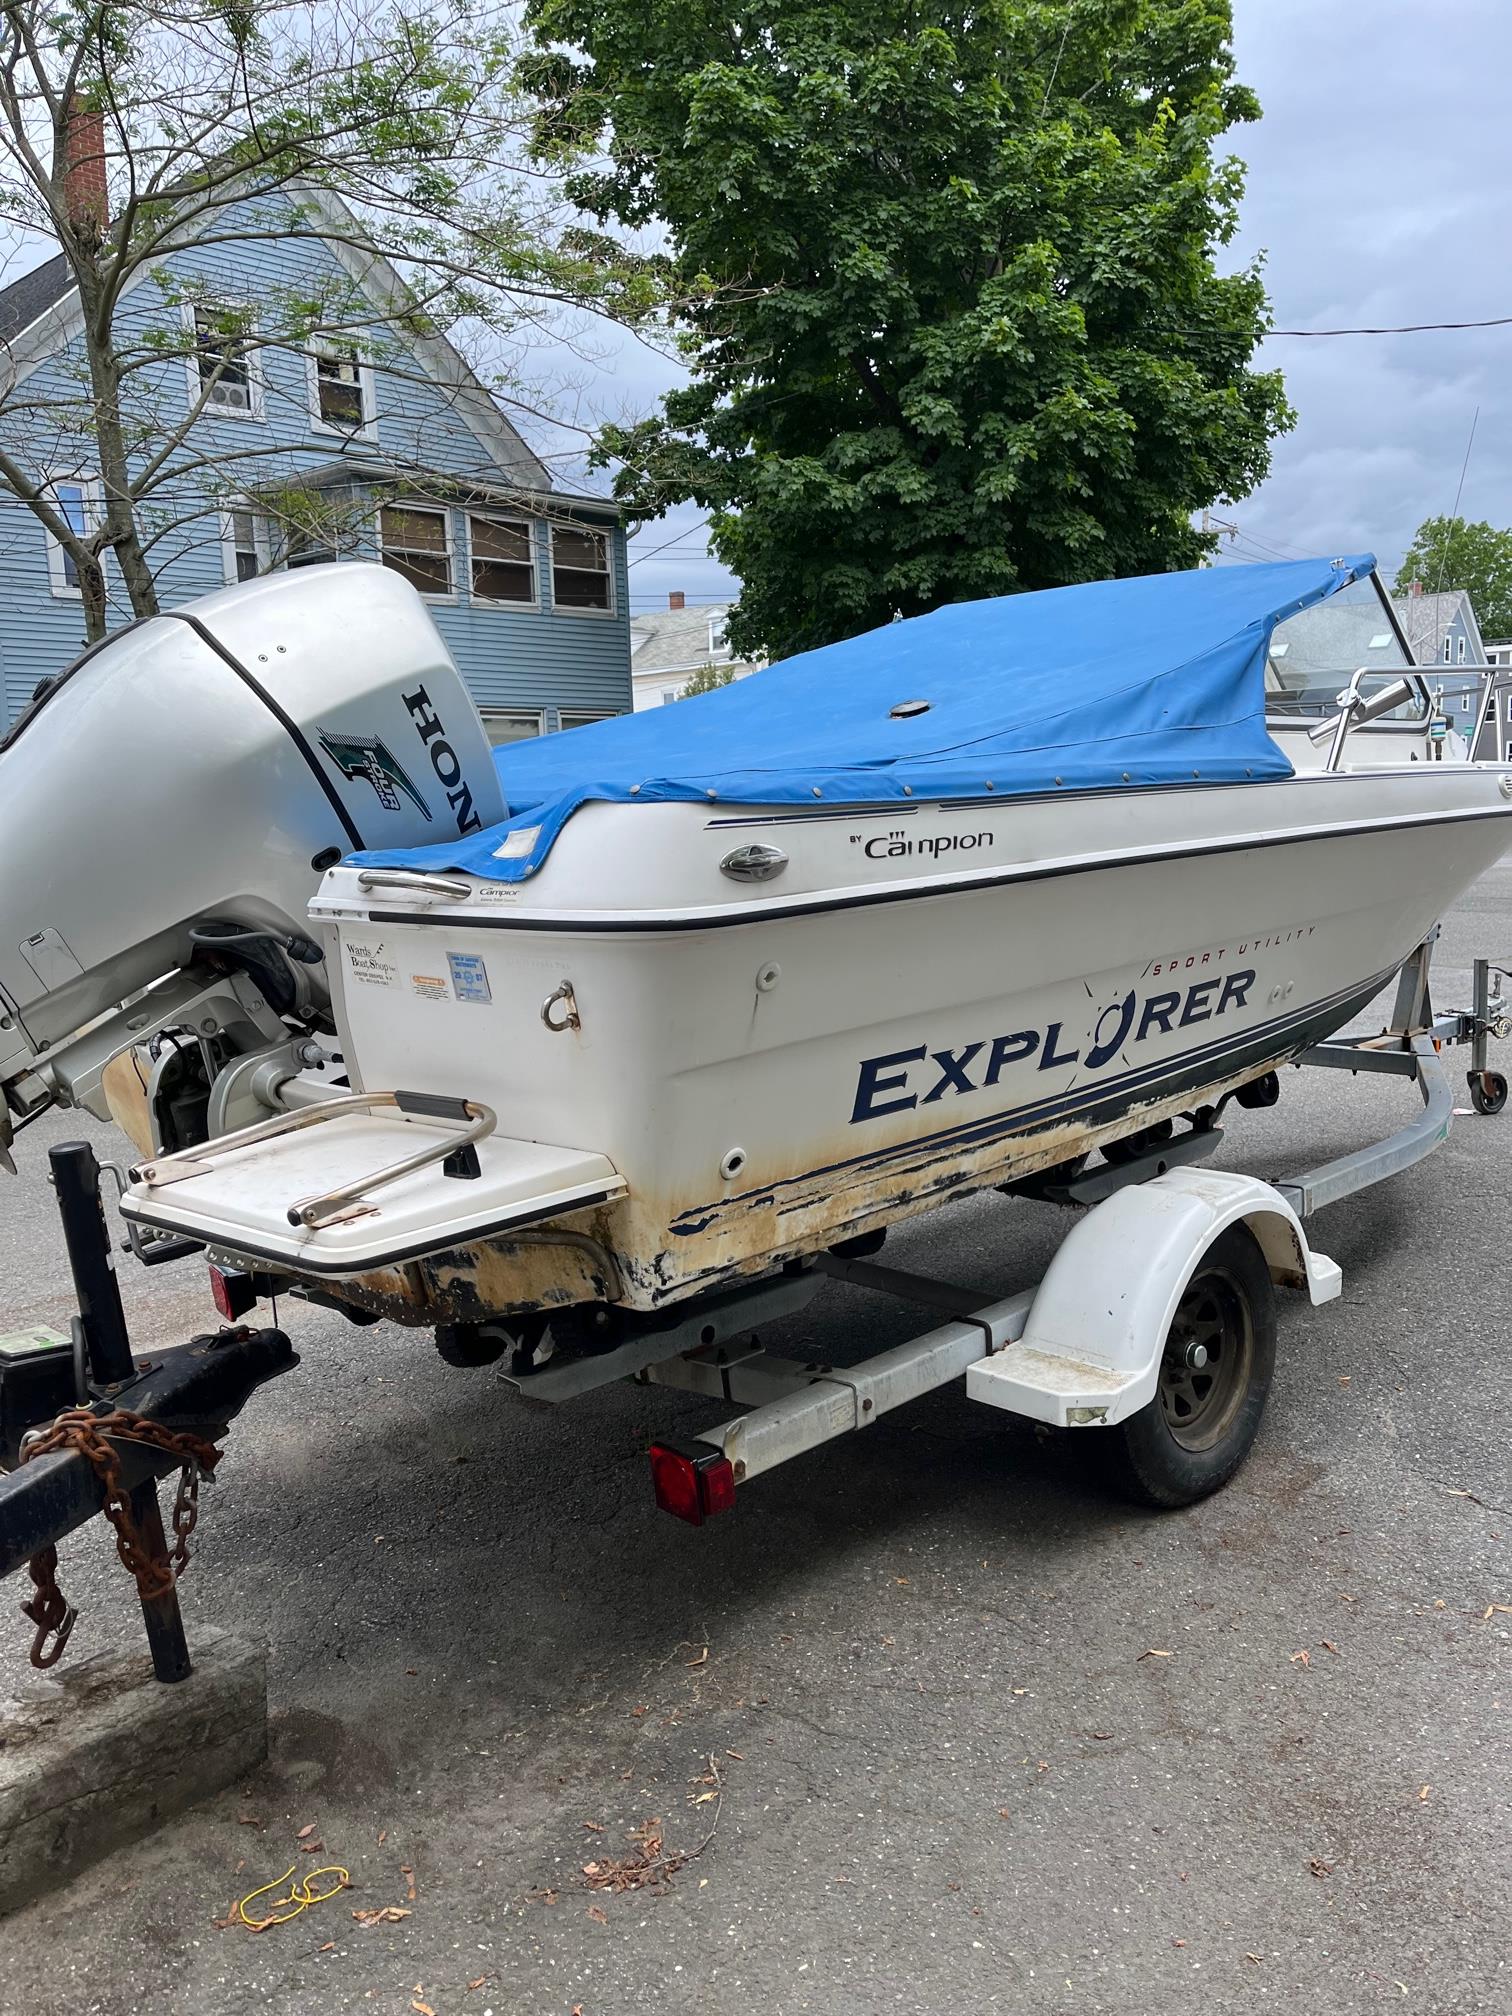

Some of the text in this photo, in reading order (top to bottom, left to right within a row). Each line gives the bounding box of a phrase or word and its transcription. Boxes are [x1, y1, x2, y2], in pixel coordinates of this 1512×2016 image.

[363, 749, 400, 810] FOUR
[363, 759, 391, 809] STROKE
[850, 831, 994, 859] BY Campion
[1152, 926, 1315, 976] SPORT UTILITY
[849, 968, 1257, 1124] EXPLORER
